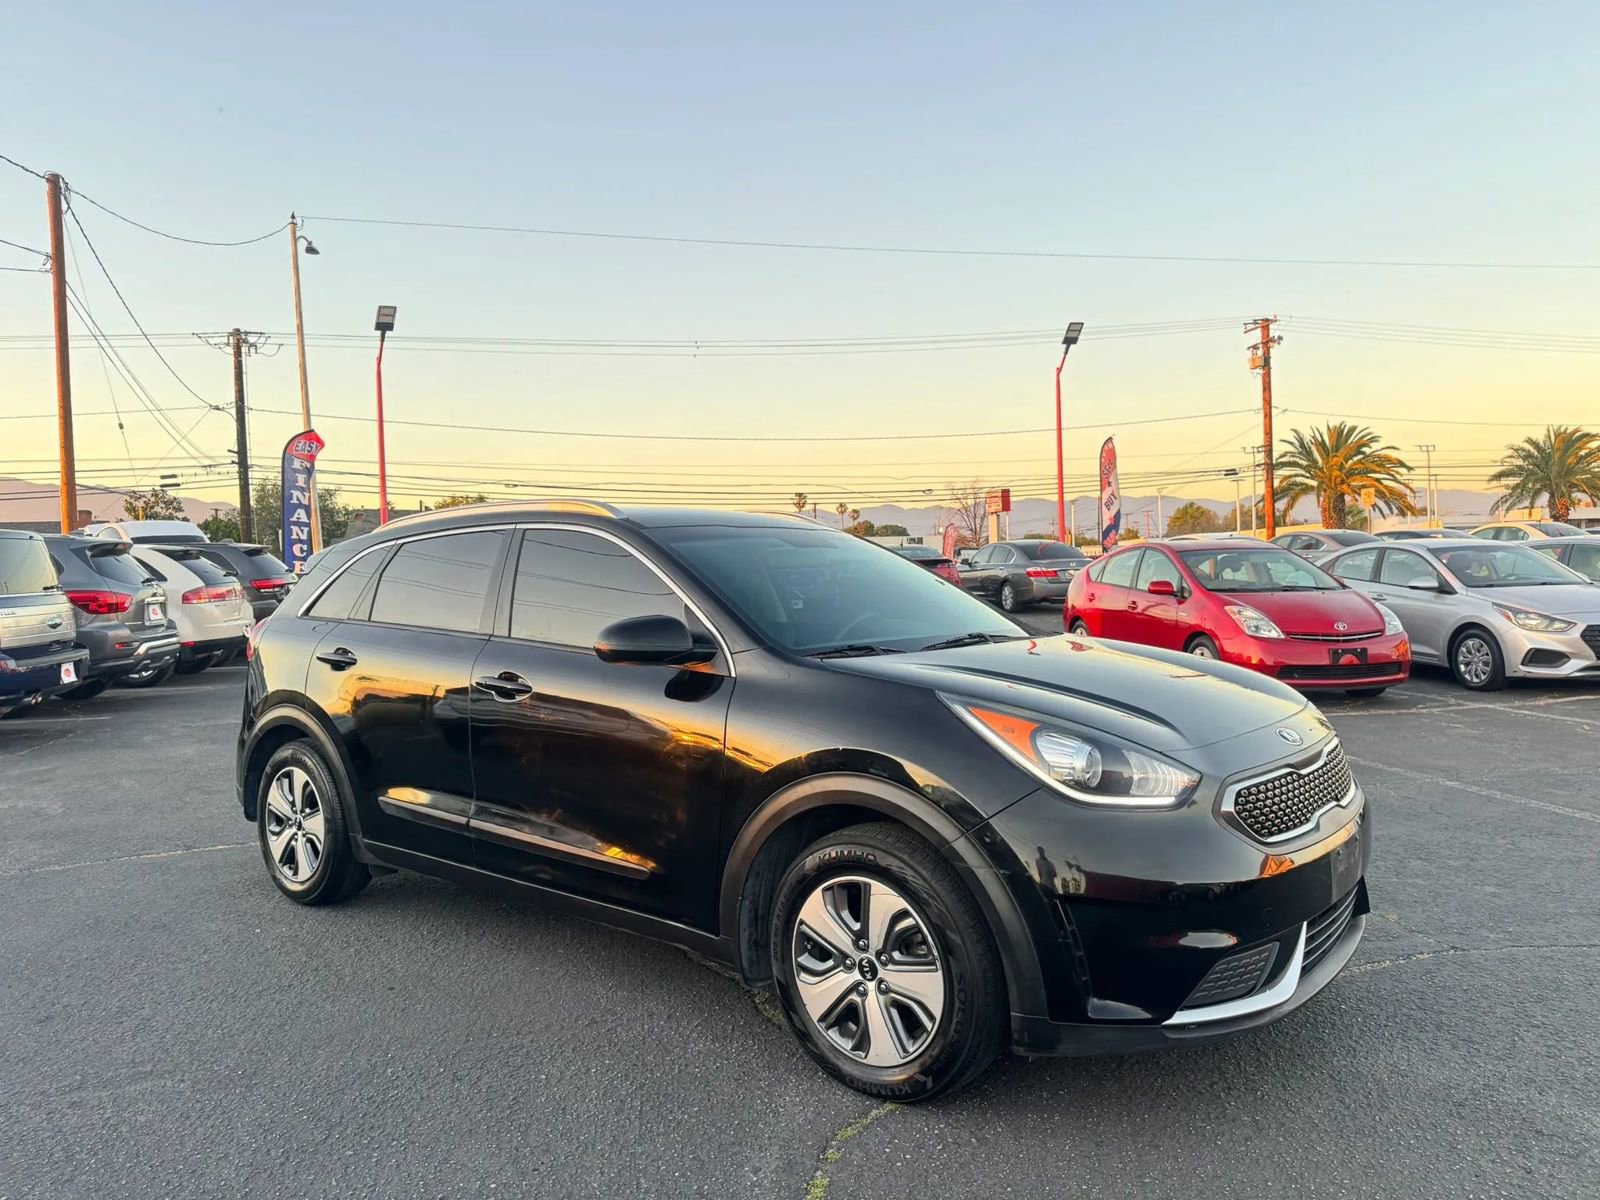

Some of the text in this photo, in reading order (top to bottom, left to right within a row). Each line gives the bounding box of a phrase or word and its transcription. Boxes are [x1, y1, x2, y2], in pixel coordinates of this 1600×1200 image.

[294, 440, 320, 454] EASY
[1104, 490, 1117, 511] BUY
[290, 457, 310, 574] FINANCE
[861, 958, 872, 980] KIA
